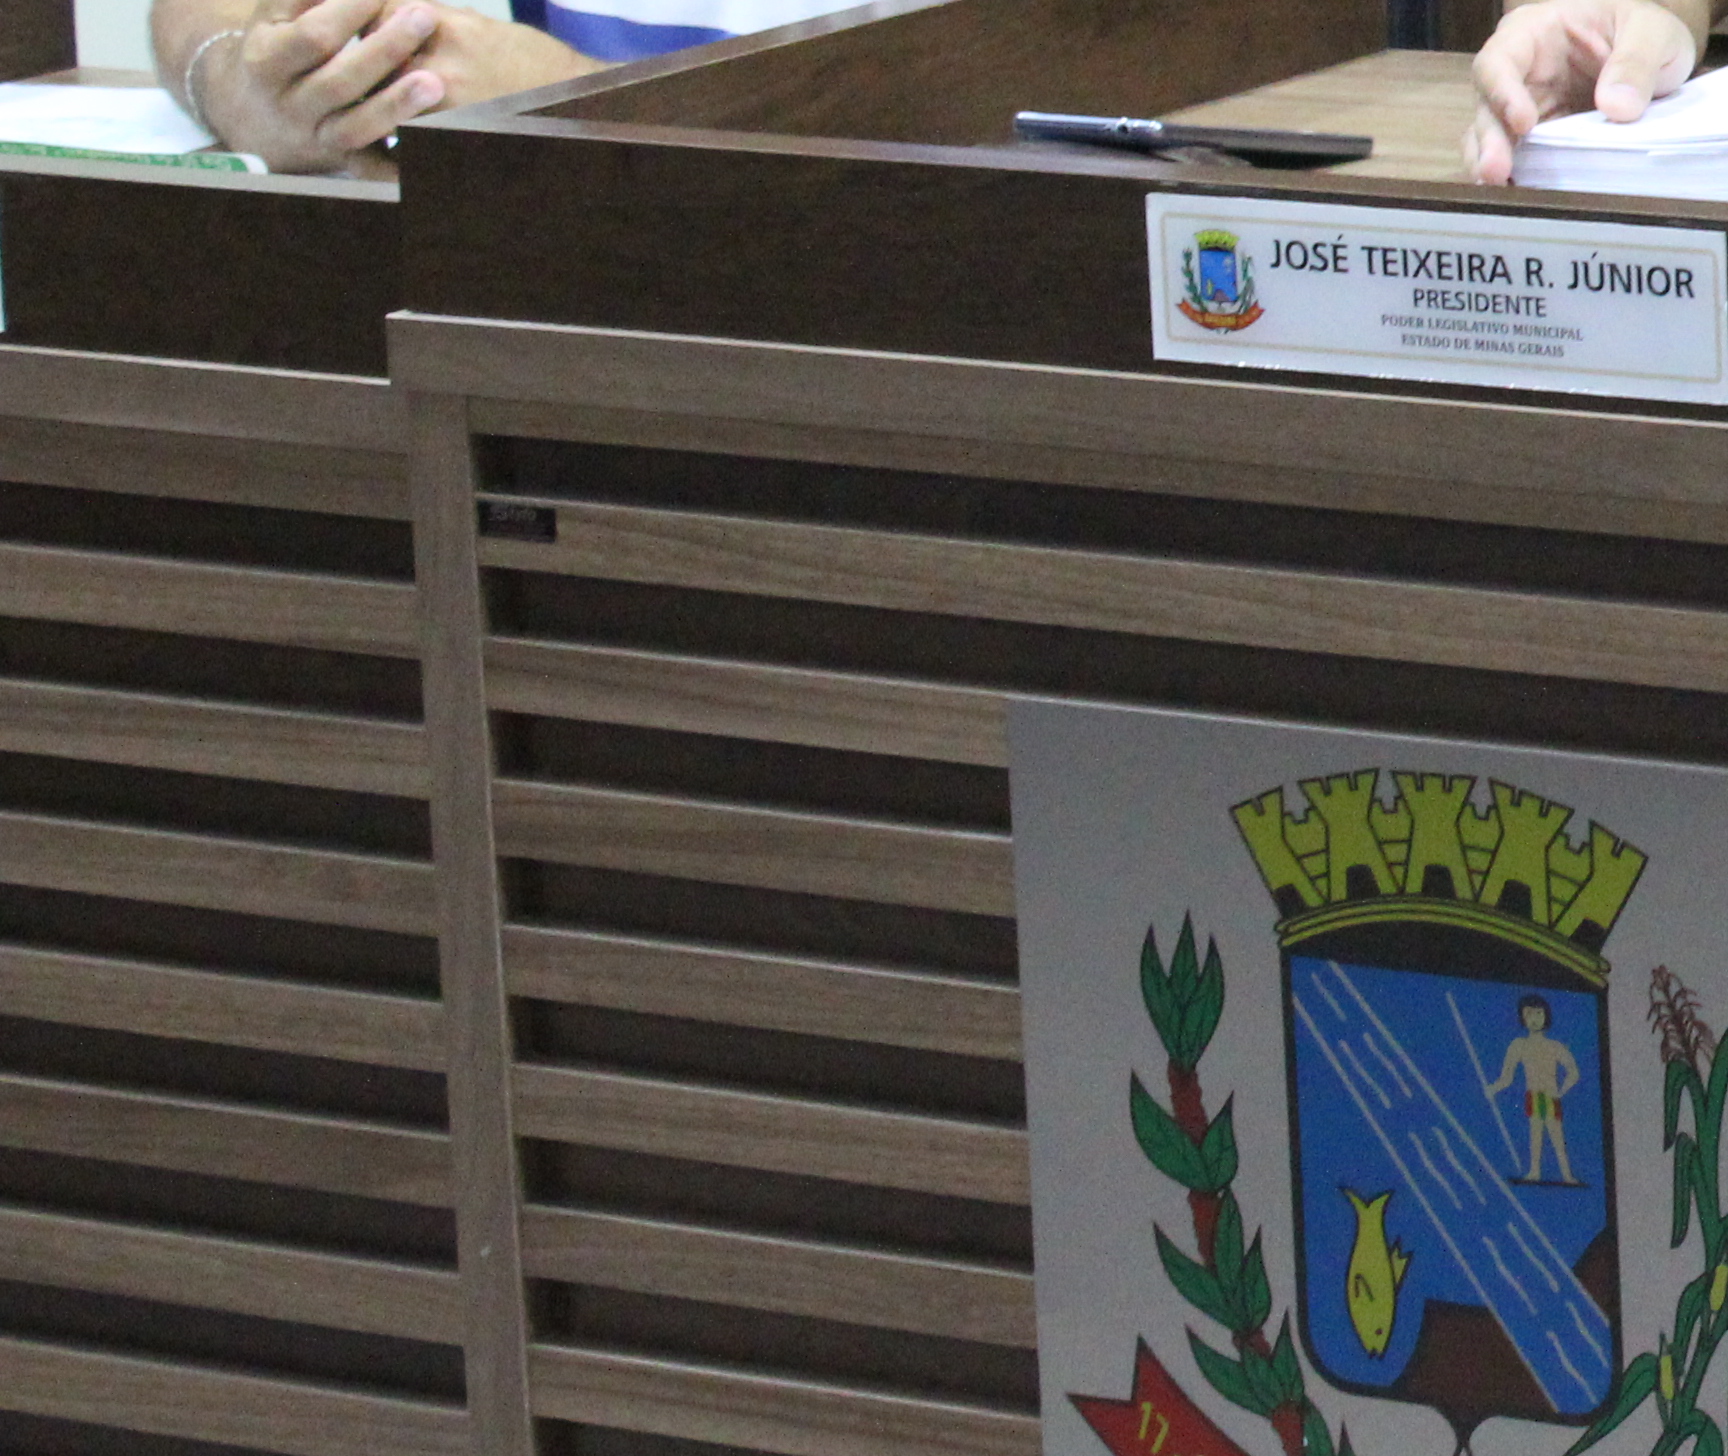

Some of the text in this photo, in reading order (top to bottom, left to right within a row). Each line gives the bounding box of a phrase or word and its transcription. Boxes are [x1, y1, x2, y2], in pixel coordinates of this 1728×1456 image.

[1270, 233, 1695, 298] JOSÉ TEIXEIRA R. JÚNIOR
[1412, 288, 1547, 318] PRESIDENTE
[1381, 314, 1584, 342] PODER LEGISLATIVO MUNICIPAL
[1401, 334, 1564, 358] ESTADO DE MINAS GERAIS
